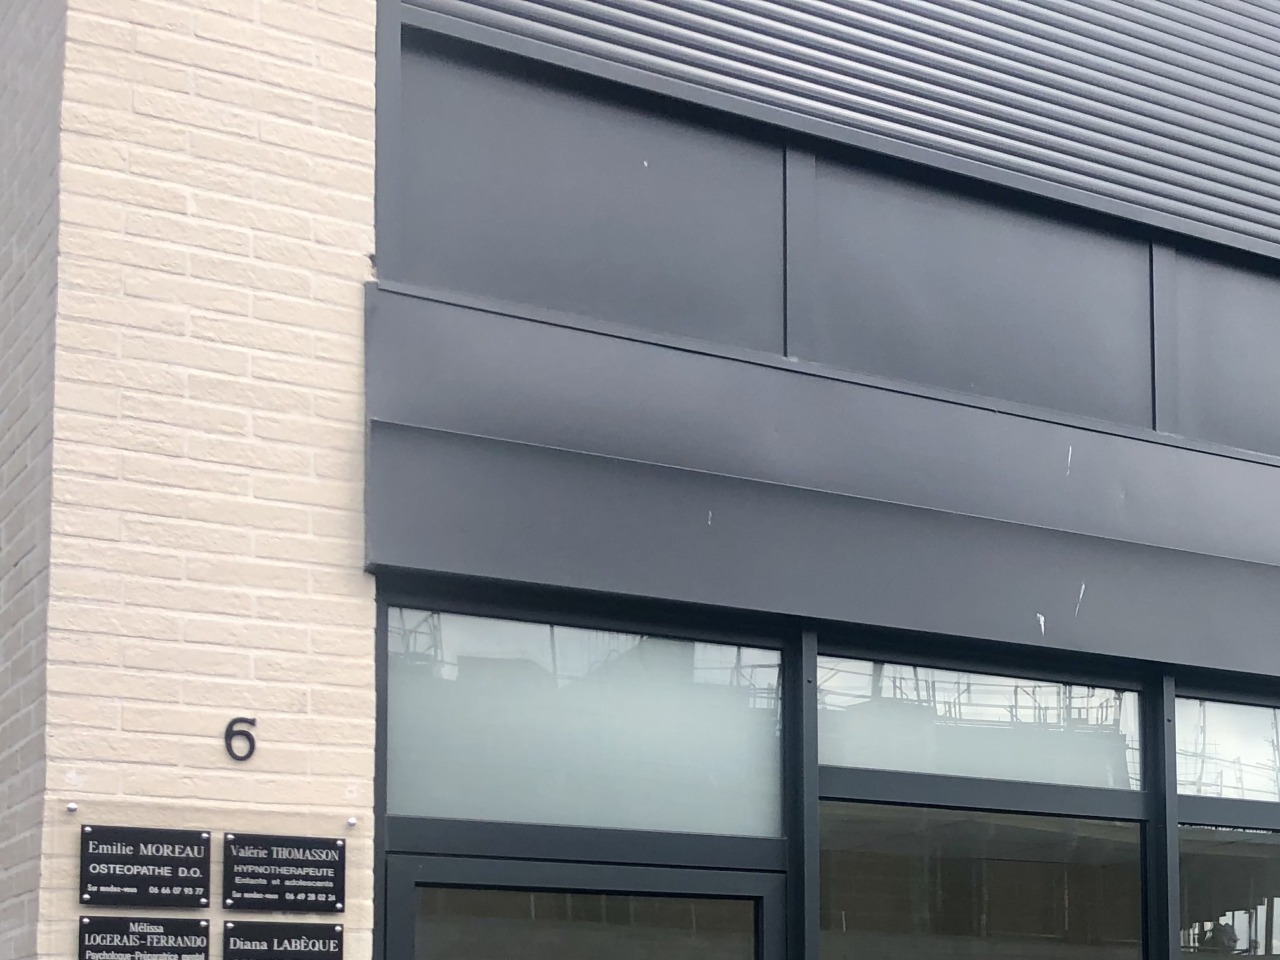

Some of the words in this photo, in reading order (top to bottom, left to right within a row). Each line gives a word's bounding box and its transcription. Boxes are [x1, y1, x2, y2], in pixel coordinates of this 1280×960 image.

[224, 716, 256, 761] 6
[88, 841, 134, 855] Emilie
[140, 843, 205, 858] MOREAU
[231, 845, 268, 858] Valérie
[271, 847, 339, 861] THOMASSON
[89, 864, 173, 876] OSTEOPATHE
[178, 867, 203, 878] D.O.
[234, 865, 335, 877] HYPNOTHERAPEUTE
[149, 886, 159, 894] 06
[129, 922, 164, 933] Mélissa
[85, 934, 207, 947] LOGERAIS-FERRANDO
[230, 937, 268, 950] Diana
[273, 936, 339, 951] LABÈQUE
